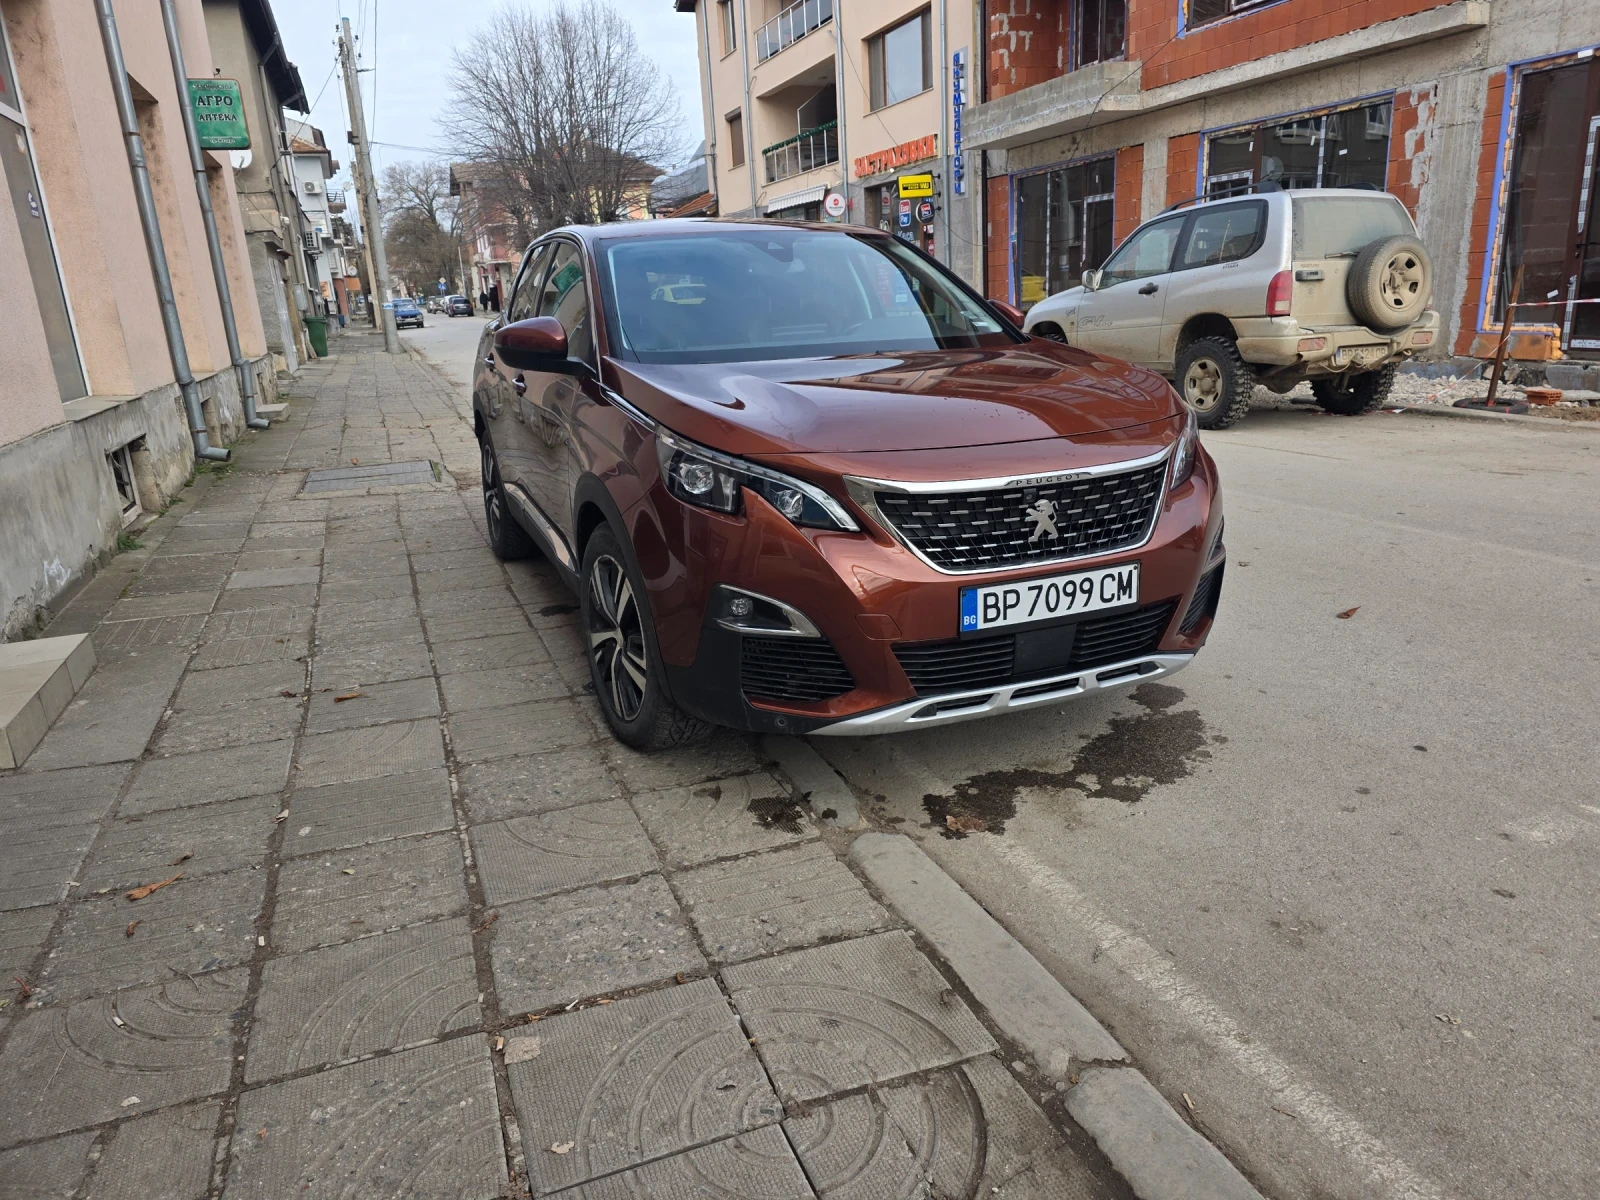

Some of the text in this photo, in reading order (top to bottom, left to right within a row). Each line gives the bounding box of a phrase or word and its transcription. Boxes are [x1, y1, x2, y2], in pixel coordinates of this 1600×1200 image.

[197, 95, 233, 107] АГРО
[199, 113, 238, 121] АПТЕКА
[953, 52, 964, 194] АКУМУЛАТОРИ
[854, 134, 935, 178] ЗАСТРАХОВКИ
[1016, 473, 1081, 486] PEUGEOT
[963, 615, 976, 626] BG
